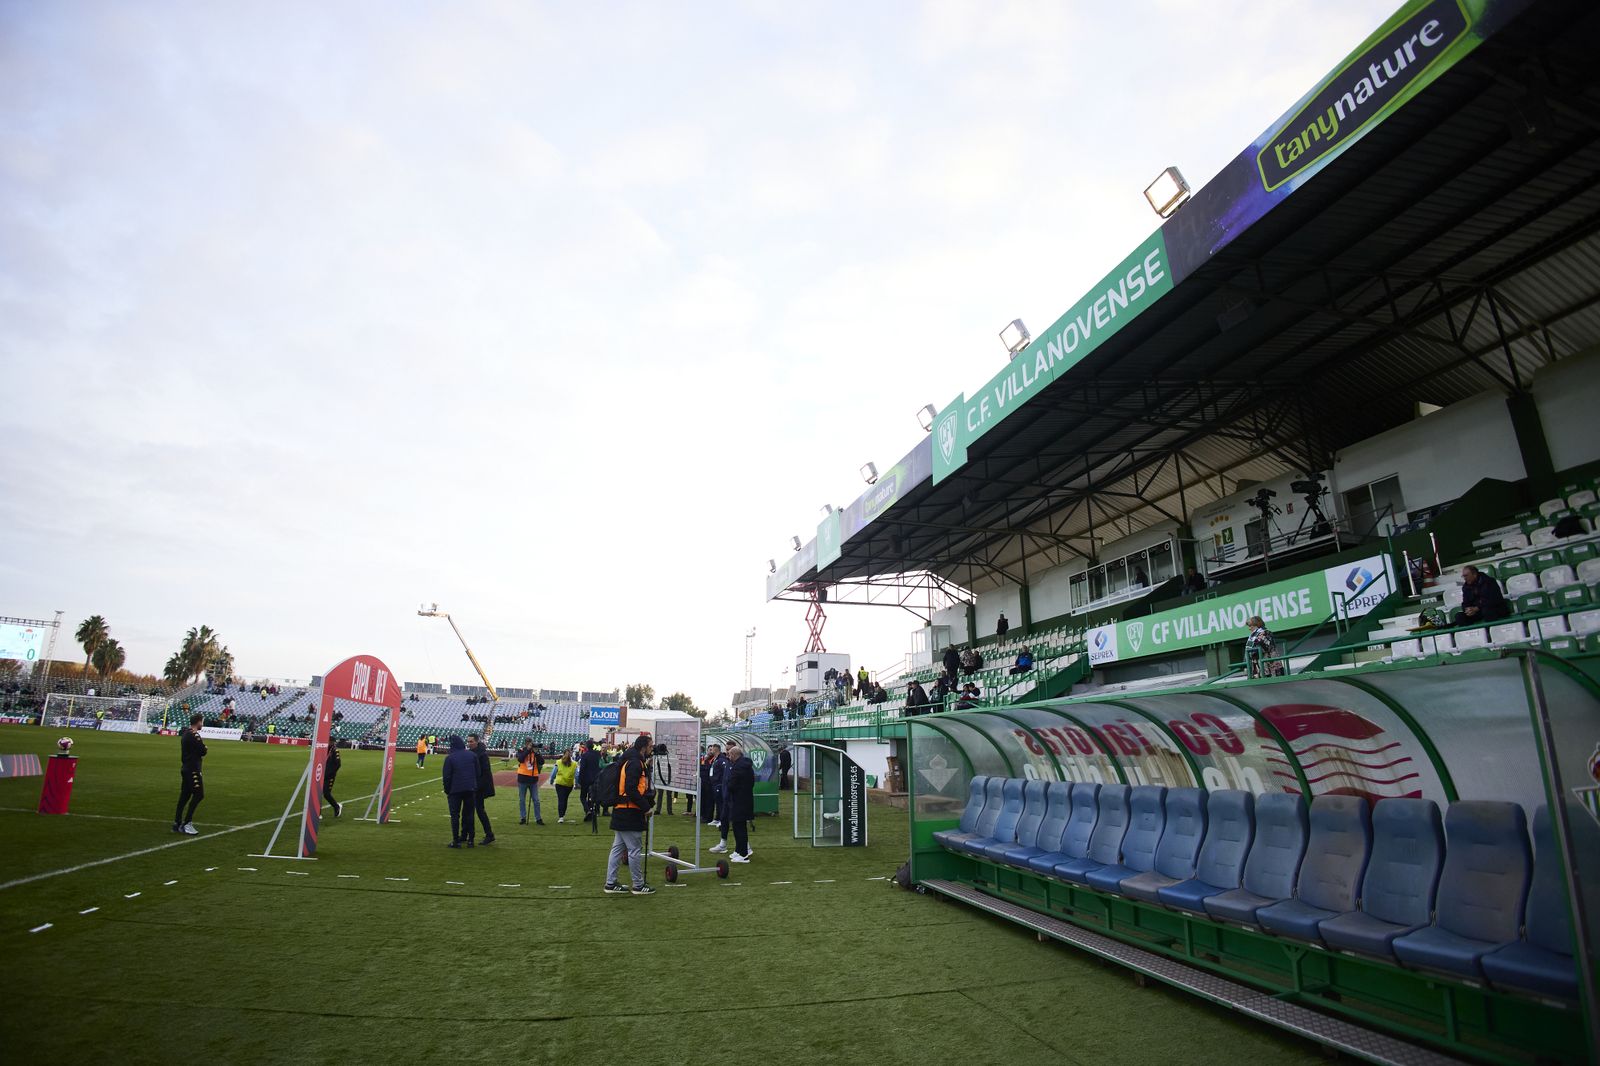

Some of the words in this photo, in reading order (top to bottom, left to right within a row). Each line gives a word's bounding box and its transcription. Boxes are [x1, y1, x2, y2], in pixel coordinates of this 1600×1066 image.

[1275, 19, 1444, 169] tanynature
[967, 396, 992, 432] C.F.
[995, 248, 1165, 408] VILLANOVENSE
[1151, 621, 1169, 645] CF
[1172, 588, 1313, 640] VILLANOVENSE
[27, 648, 35, 660] 0
[1090, 649, 1114, 661] SEPREX
[848, 765, 860, 843] www.aluminiosreyes.es
